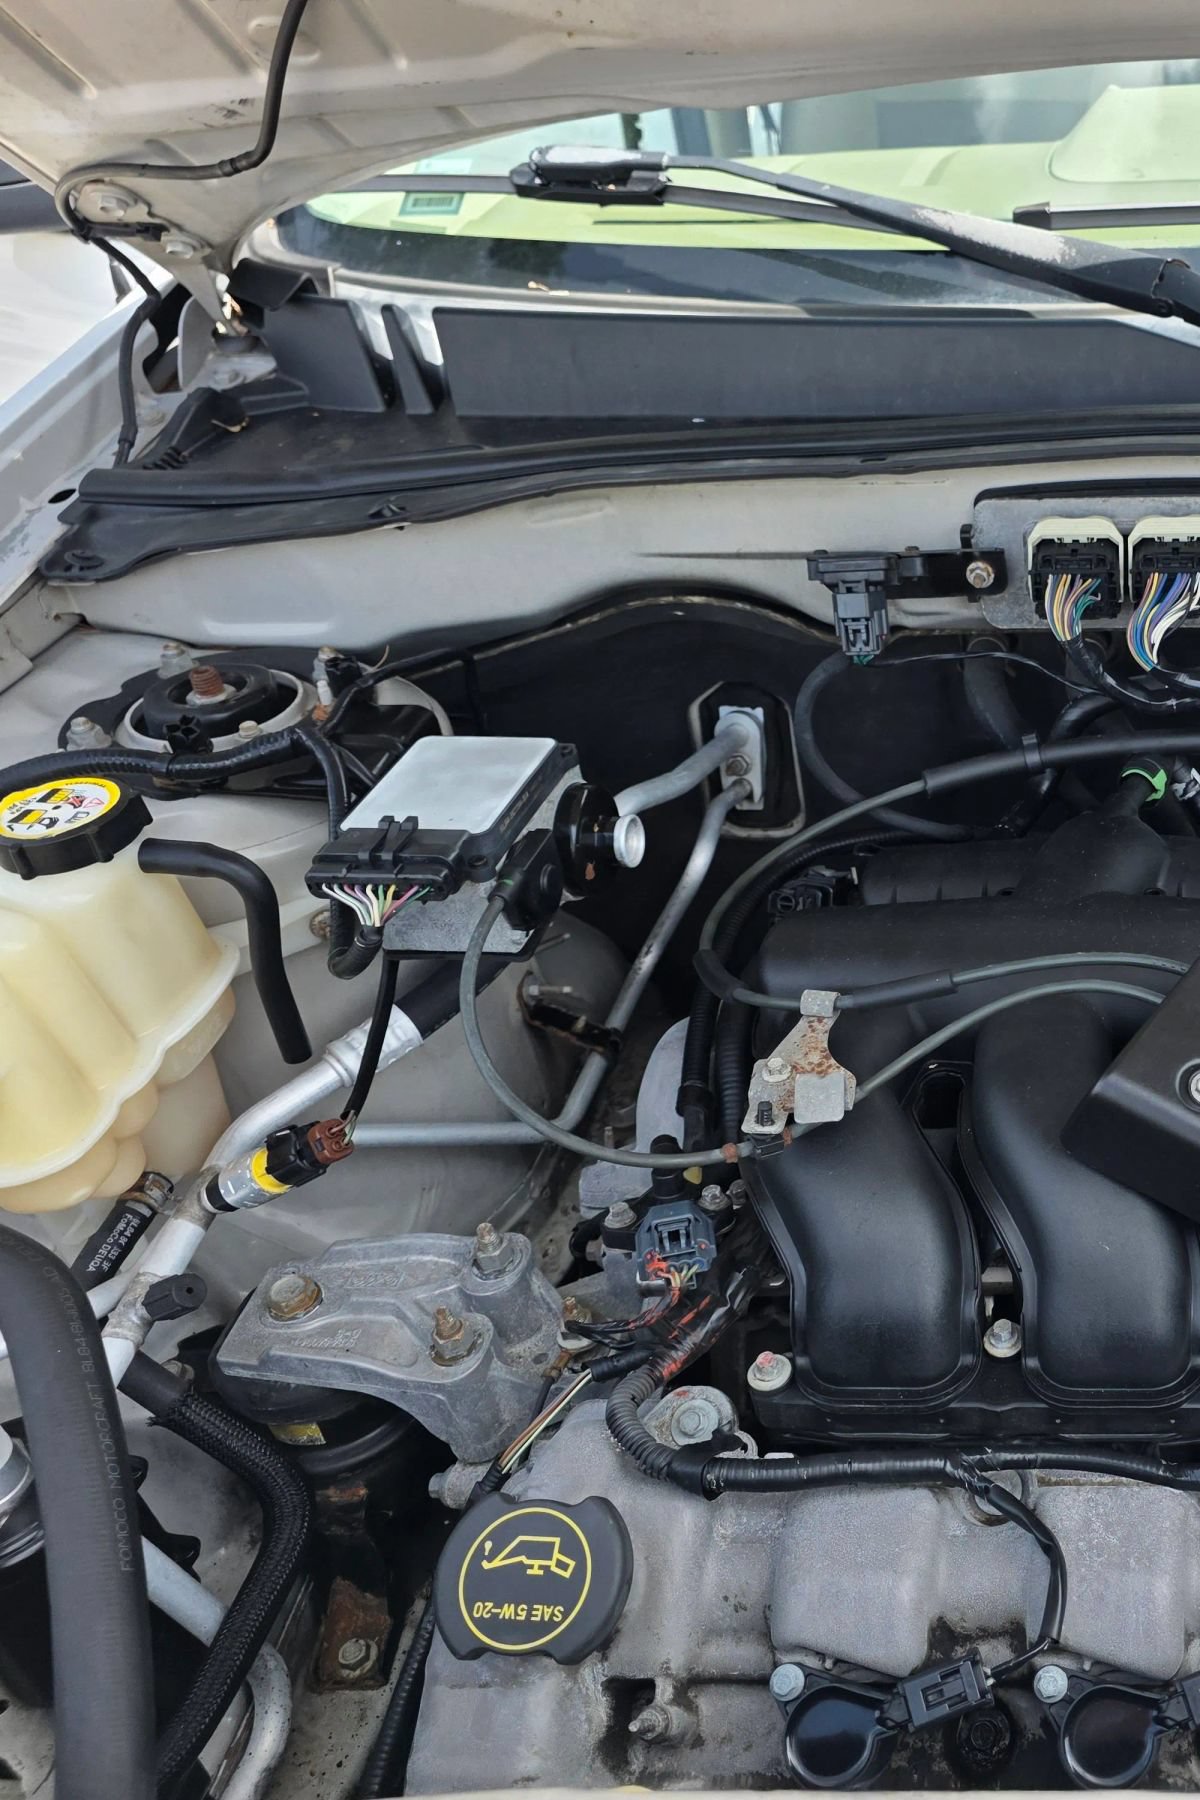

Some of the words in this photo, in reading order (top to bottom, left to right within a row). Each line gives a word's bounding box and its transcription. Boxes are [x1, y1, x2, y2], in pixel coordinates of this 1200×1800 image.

[87, 1382, 124, 1489] MOTORCRAFT
[112, 1497, 135, 1572] FOMOCO
[473, 1601, 528, 1620] 5W-20
[531, 1604, 565, 1622] SAE
